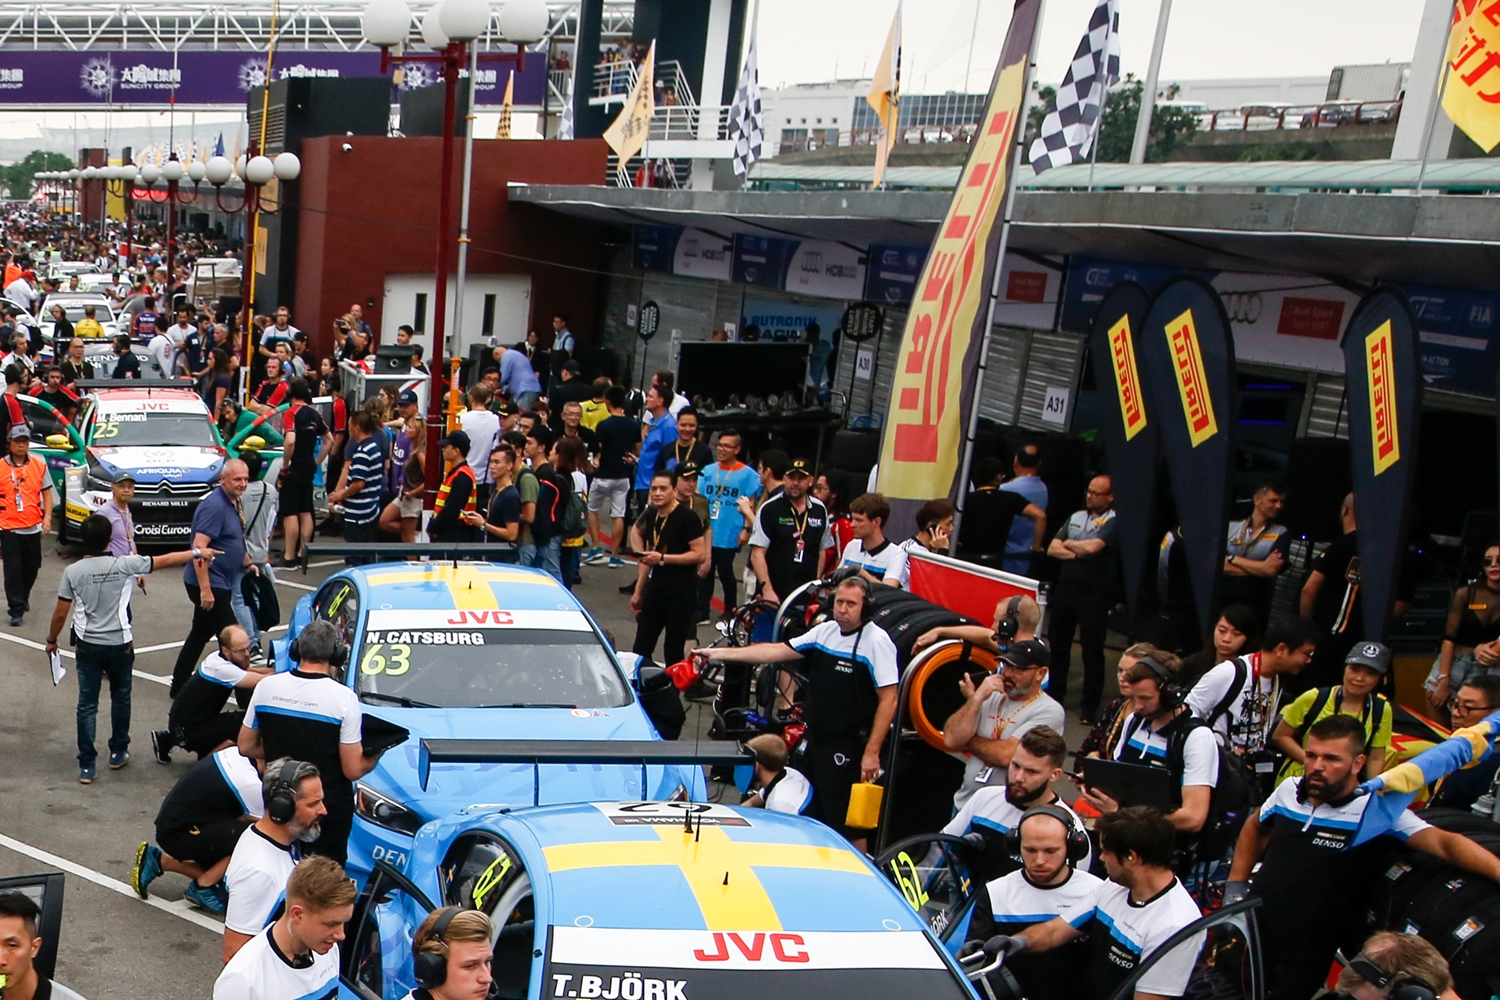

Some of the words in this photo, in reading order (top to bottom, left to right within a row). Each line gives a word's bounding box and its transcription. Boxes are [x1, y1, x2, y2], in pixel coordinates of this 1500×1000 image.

[857, 355, 872, 372] A30
[136, 402, 170, 411] JVC
[1045, 395, 1066, 414] A31
[109, 412, 148, 422] Bennani
[93, 422, 121, 439] 25
[136, 467, 183, 475] AFRIQUIA
[447, 610, 514, 625] JVC
[366, 630, 485, 647] N.CATSBURG
[360, 643, 412, 676] 63
[1312, 837, 1346, 850] DENSO
[372, 843, 407, 867] DEN
[693, 932, 810, 964] JVC
[1108, 952, 1134, 971] DENSO
